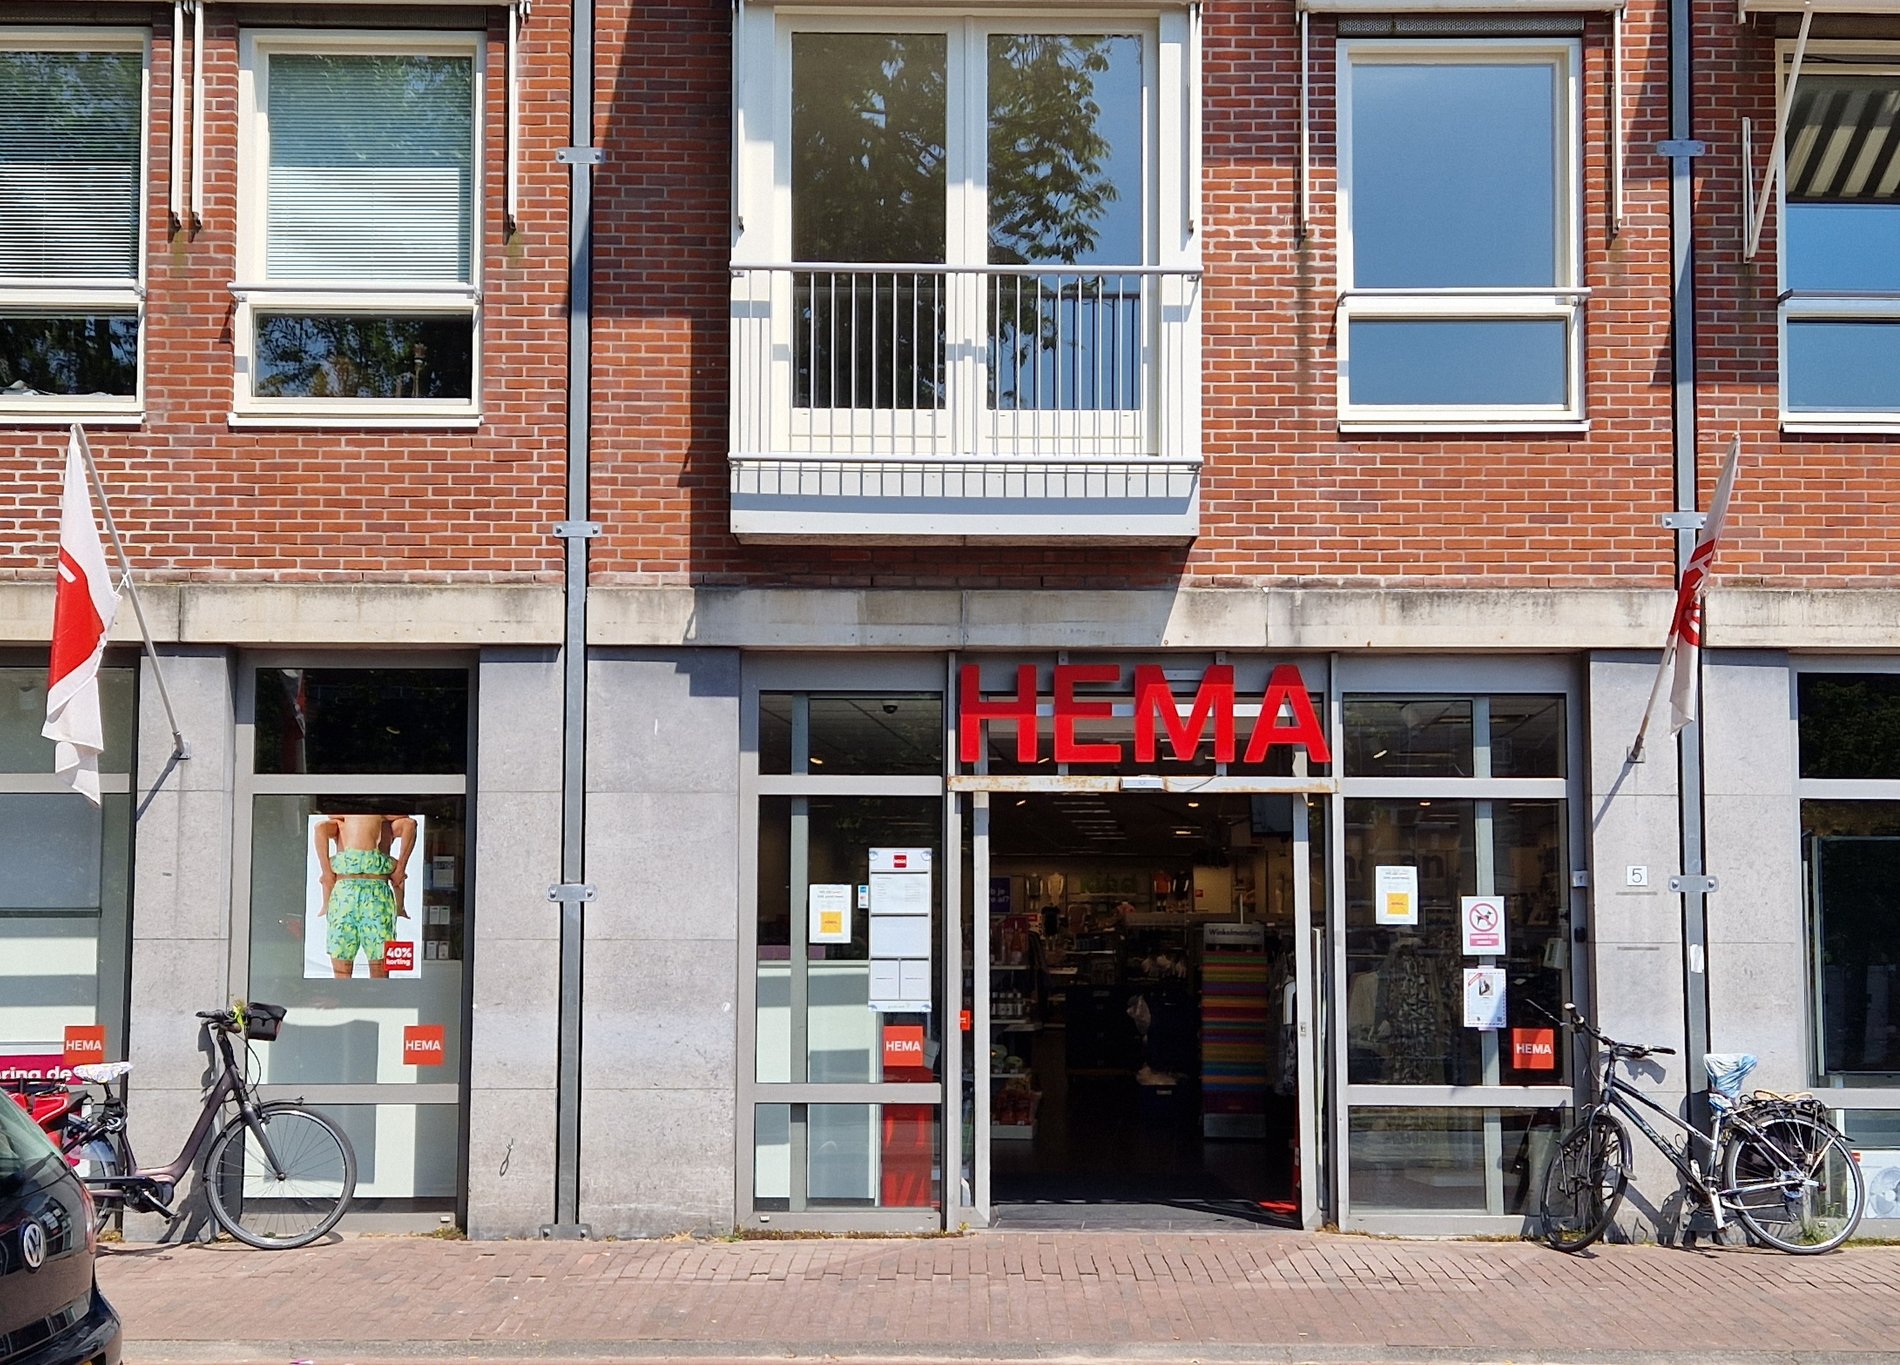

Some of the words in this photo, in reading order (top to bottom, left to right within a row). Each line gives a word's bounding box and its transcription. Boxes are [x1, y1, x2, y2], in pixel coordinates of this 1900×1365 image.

[960, 664, 1331, 763] HEMA
[1631, 867, 1643, 883] 5
[386, 947, 412, 958] 40%
[385, 958, 411, 967] korting
[65, 1040, 103, 1051] HEMA
[405, 1040, 441, 1051] HEMA
[885, 1041, 921, 1052] HEMA
[1515, 1043, 1552, 1054] HEMA
[0, 1066, 41, 1080] ring
[46, 1065, 73, 1081] de
